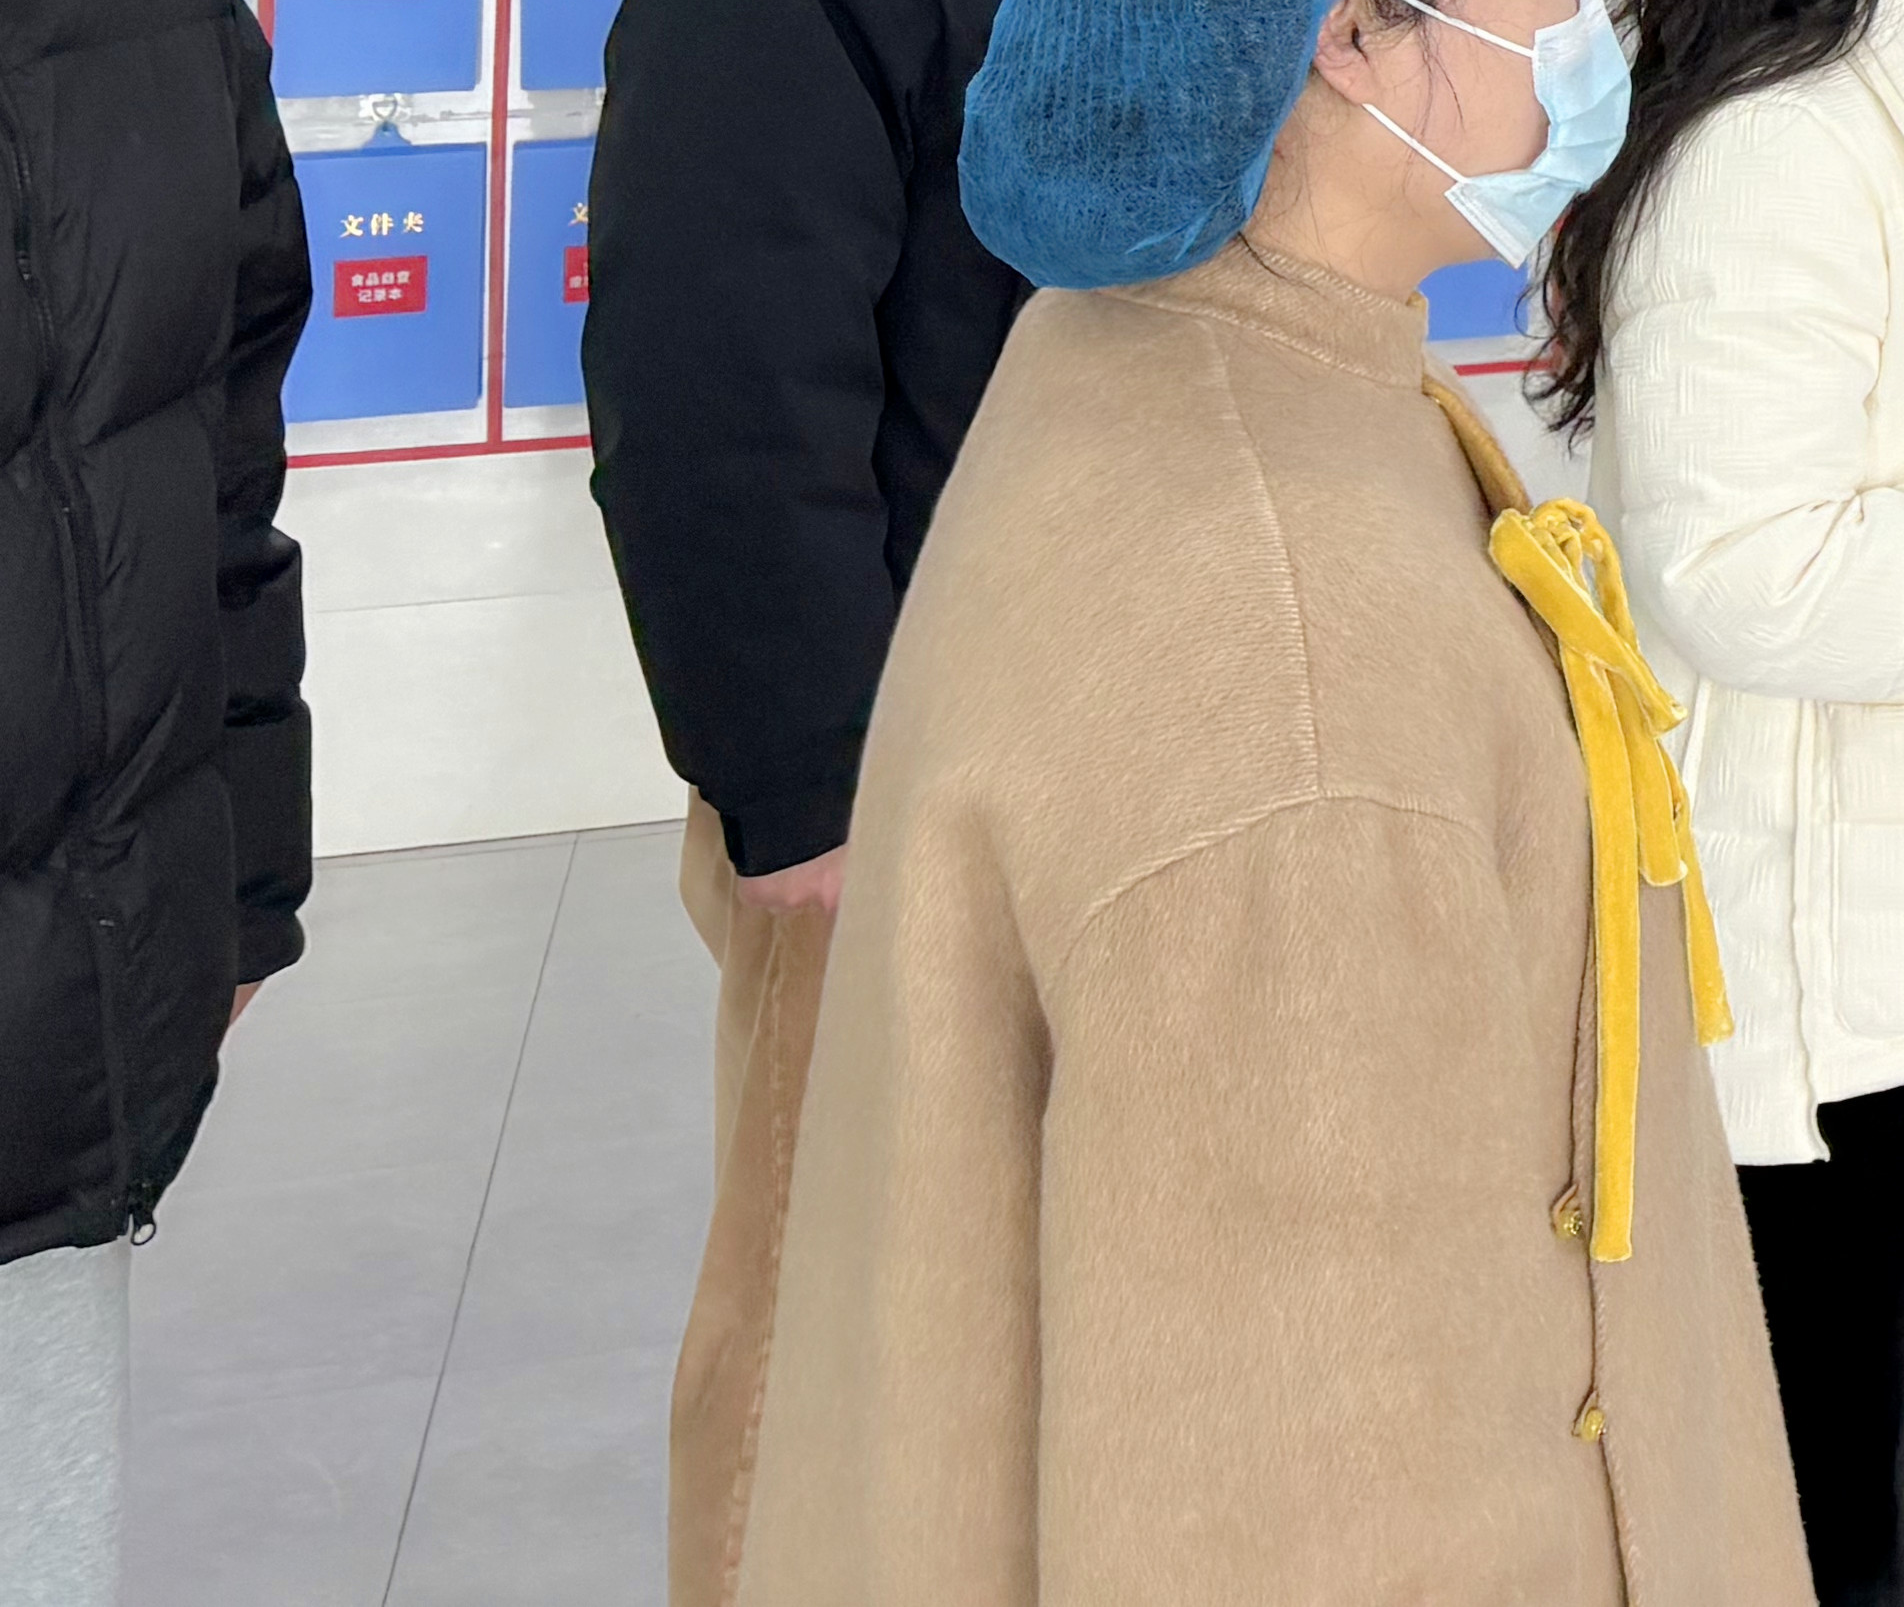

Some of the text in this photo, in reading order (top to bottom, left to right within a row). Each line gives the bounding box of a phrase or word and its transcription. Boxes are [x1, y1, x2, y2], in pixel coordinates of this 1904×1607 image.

[340, 211, 424, 238] 文件夹
[358, 287, 403, 303] 记录本
